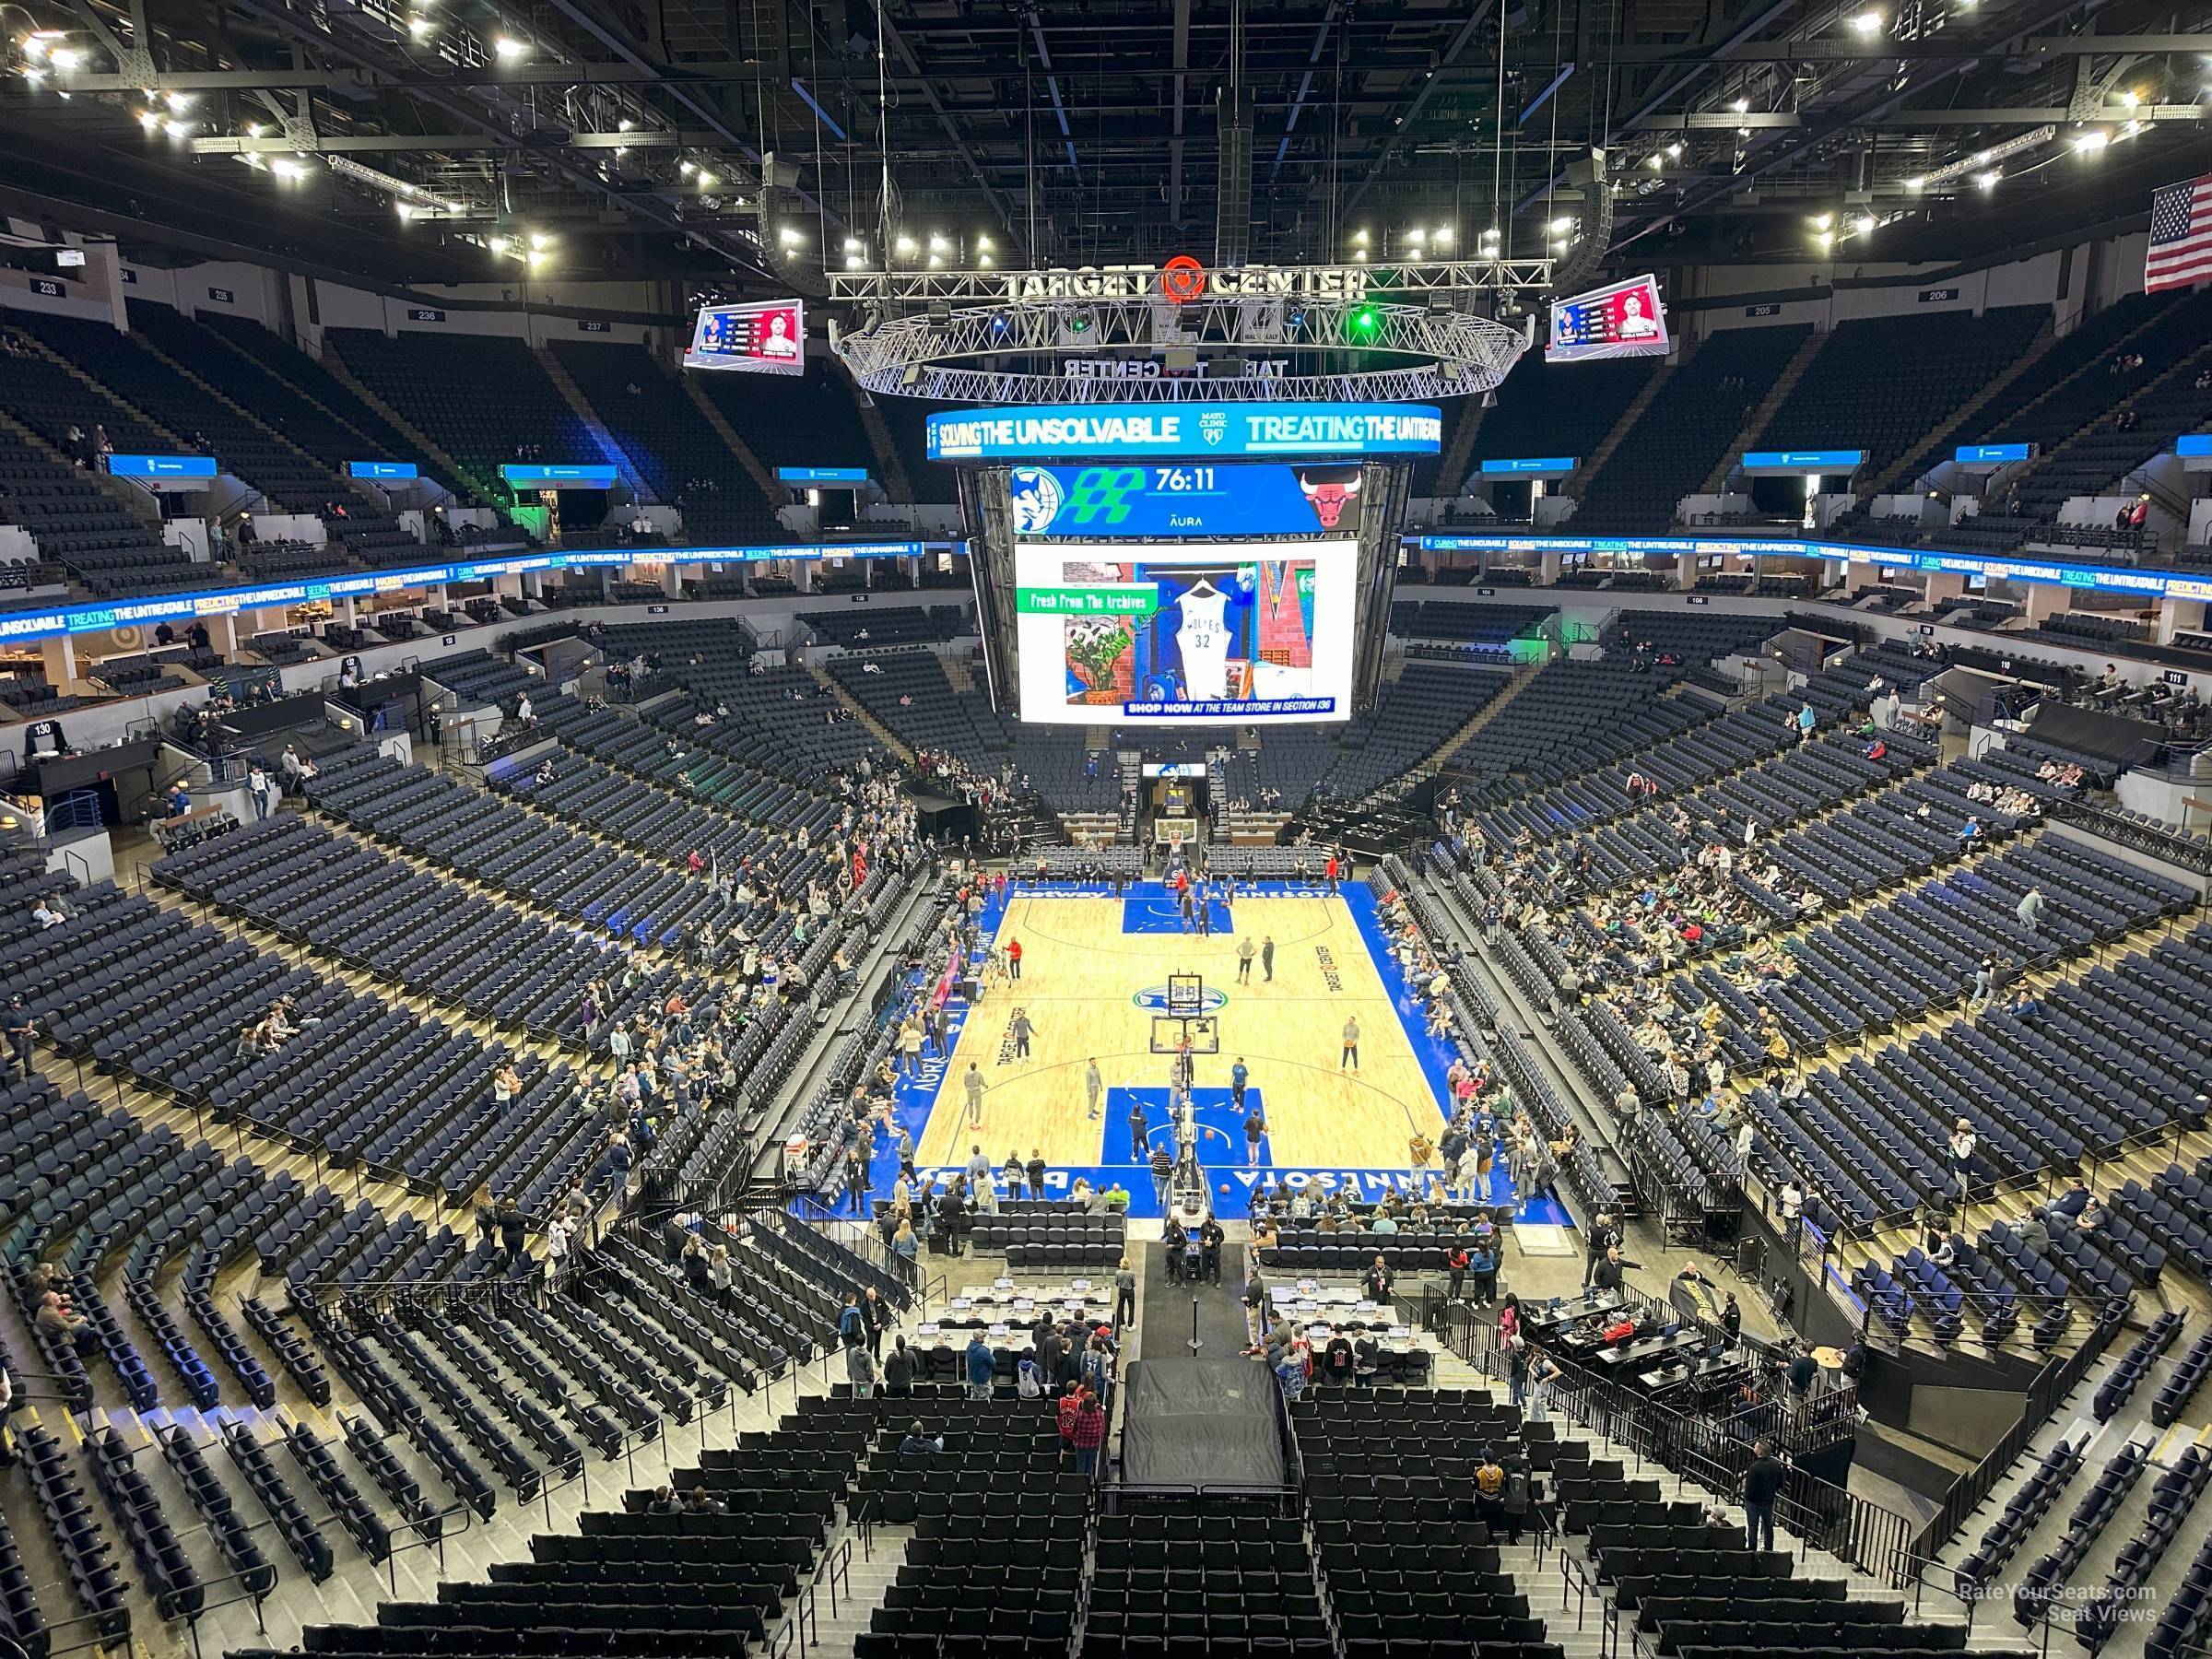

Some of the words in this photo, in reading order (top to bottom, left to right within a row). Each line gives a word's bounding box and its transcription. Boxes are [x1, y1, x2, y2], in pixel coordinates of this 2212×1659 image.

[40, 282, 56, 295] 233
[1001, 265, 1156, 302] TARGET
[1212, 265, 1368, 300] CENTER
[215, 290, 228, 300] 235
[1929, 291, 1947, 300] 206
[418, 311, 435, 321] 236
[1755, 307, 1771, 315] 205
[587, 323, 601, 331] 237
[1199, 419, 1228, 428] CLINIC
[1246, 416, 1364, 441] TREATING
[1364, 416, 1396, 440] THE
[939, 421, 982, 447] SOLVING
[1016, 417, 1180, 444] UNSOLVABLE
[1156, 468, 1214, 490] 76:11
[1030, 593, 1057, 608] Fresh
[1059, 594, 1084, 608] From
[1086, 594, 1103, 608] The
[1107, 595, 1147, 609] Archives
[1195, 634, 1210, 648] 32
[2002, 660, 2010, 669] 110
[2170, 673, 2181, 683] 111
[1129, 703, 1162, 712] SHOP
[1164, 702, 1193, 712] NOW
[1193, 704, 1204, 712] AT
[1206, 703, 1221, 712] THE
[1222, 702, 1244, 712] TEAM
[1244, 702, 1272, 712] STORE
[1272, 702, 1281, 712] IN
[1282, 700, 1316, 711] SECTION
[35, 723, 50, 735] 130
[1014, 890, 1107, 899] betway
[1022, 1372, 1028, 1381] 5
